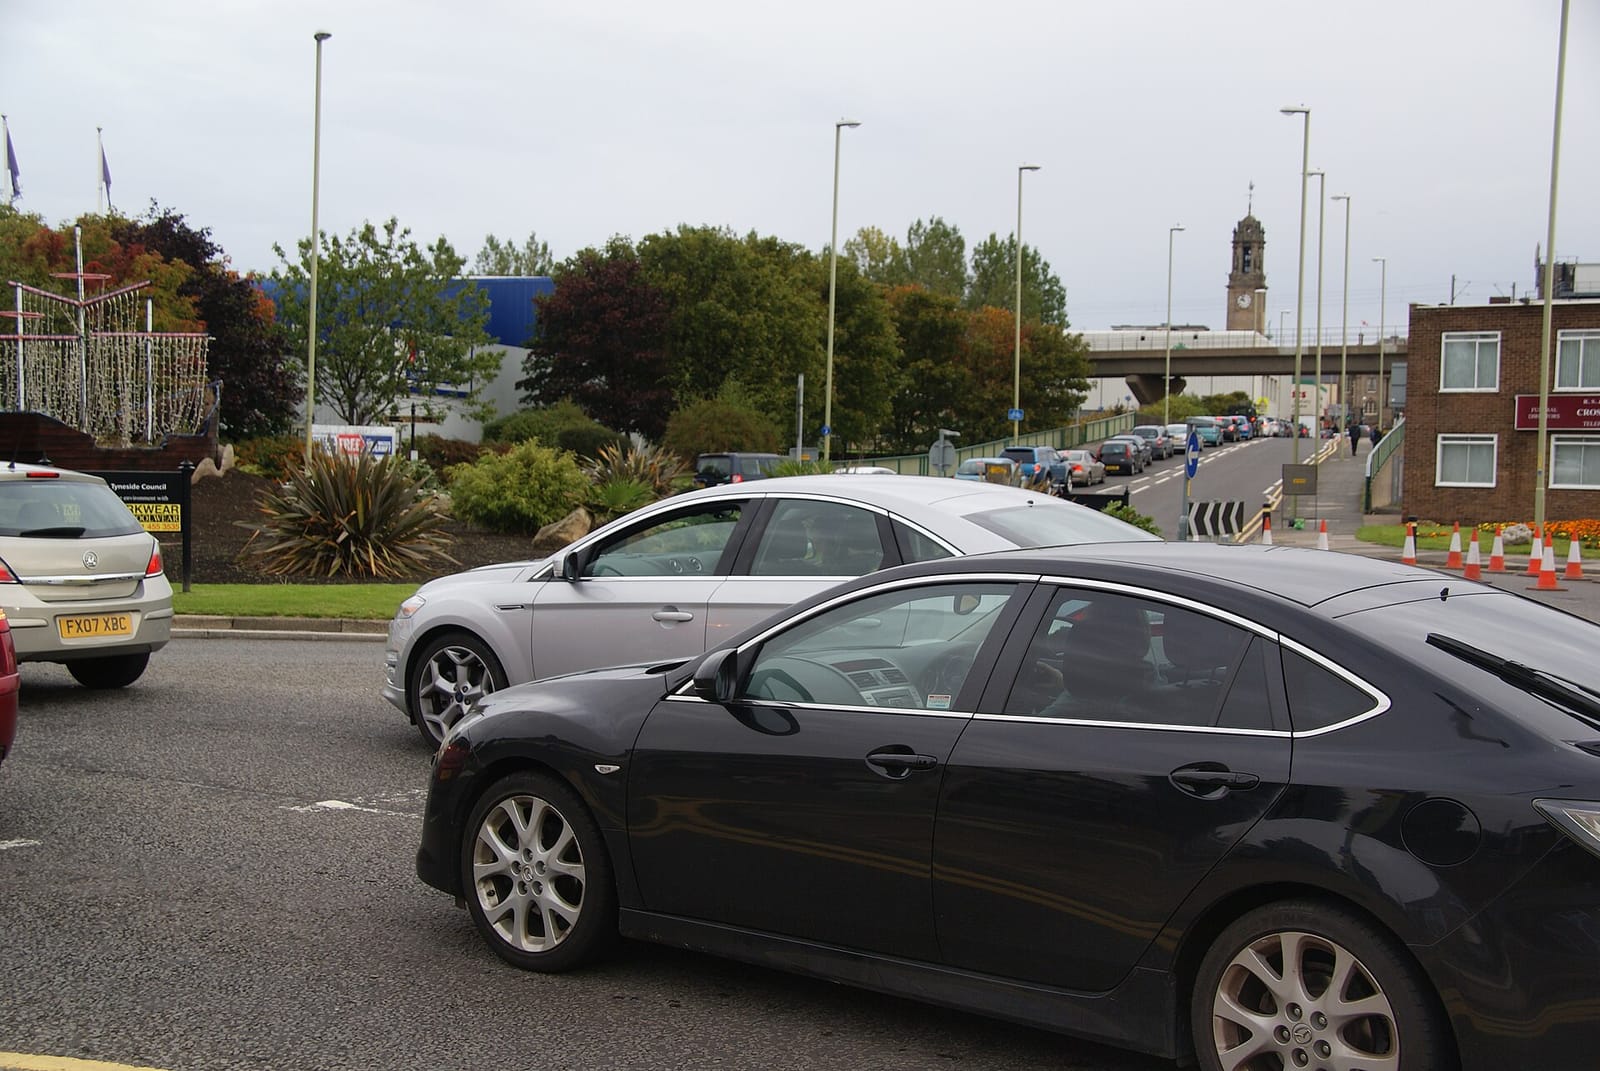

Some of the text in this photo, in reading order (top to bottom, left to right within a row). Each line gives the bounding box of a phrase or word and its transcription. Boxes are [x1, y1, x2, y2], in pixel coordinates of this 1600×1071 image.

[110, 483, 140, 491] Tyneside
[66, 616, 127, 634] FX07 XBC
